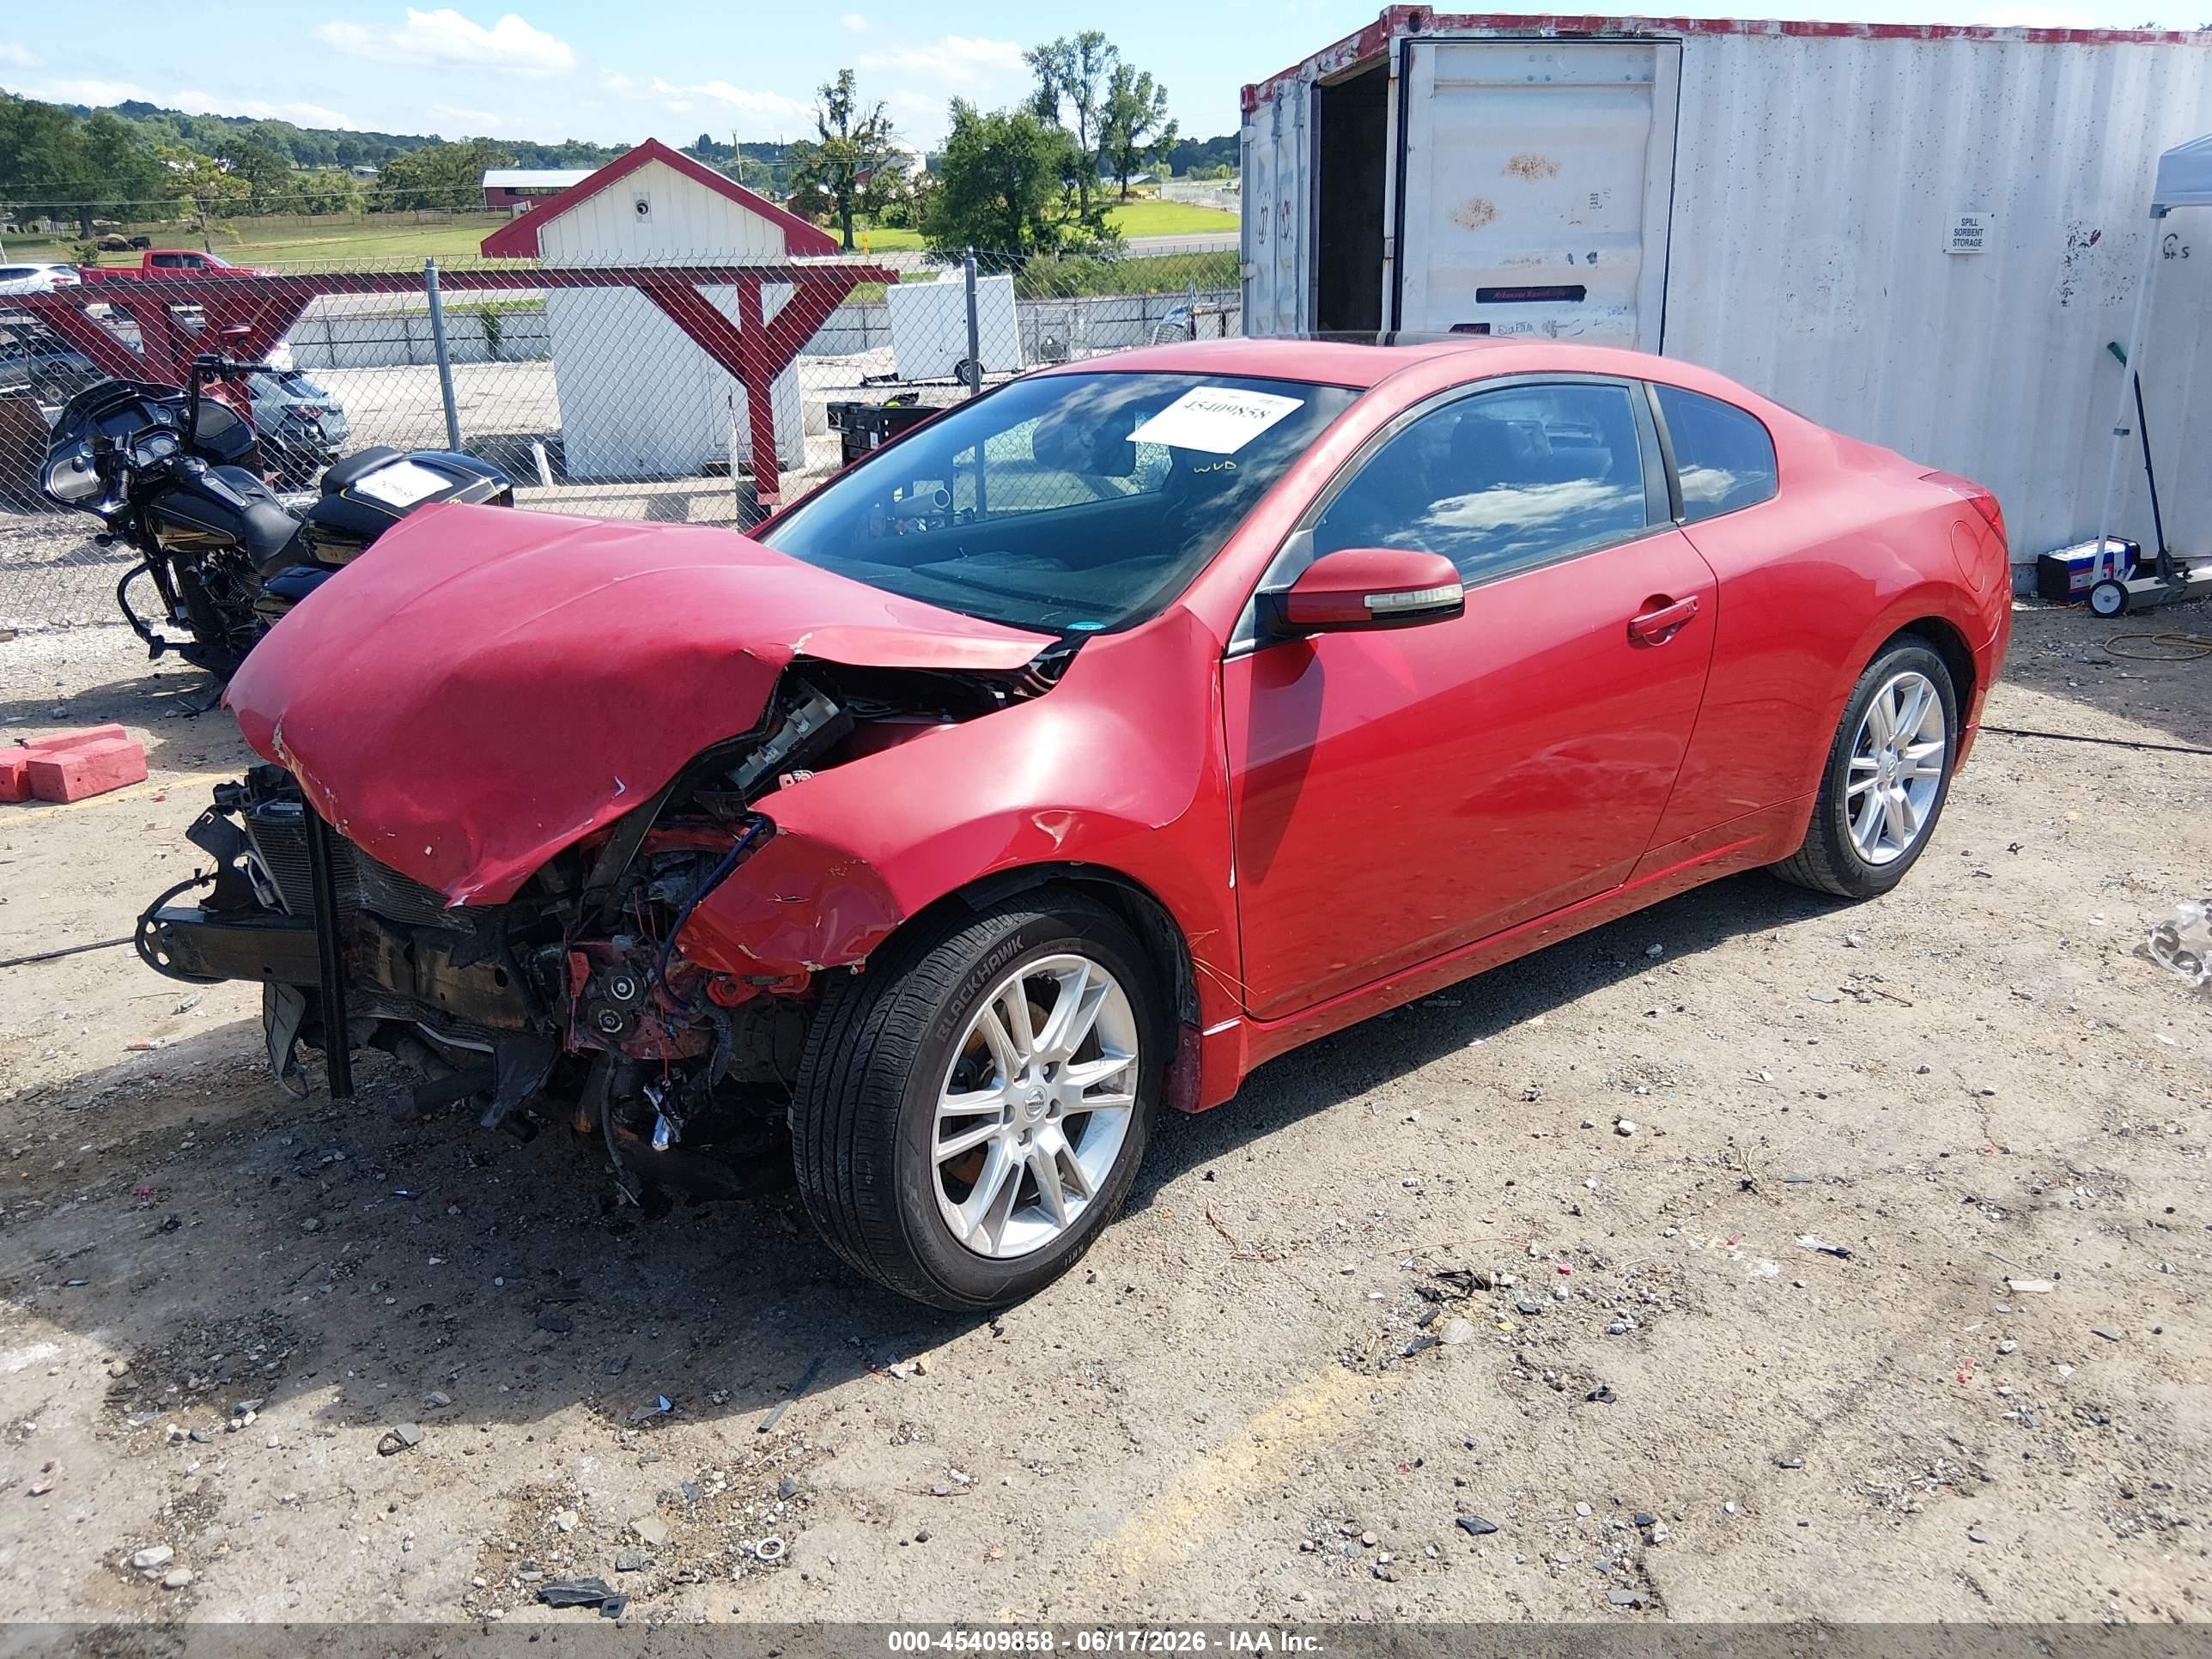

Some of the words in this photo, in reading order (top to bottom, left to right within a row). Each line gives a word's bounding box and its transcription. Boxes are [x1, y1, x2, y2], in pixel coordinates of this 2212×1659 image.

[1961, 217, 1978, 227] SPILL
[1954, 228, 1984, 237] SORBENT
[1952, 238, 1983, 247] STORAGE
[1183, 400, 1271, 419] 45409858
[935, 935, 1024, 1043] BLACKHAWK
